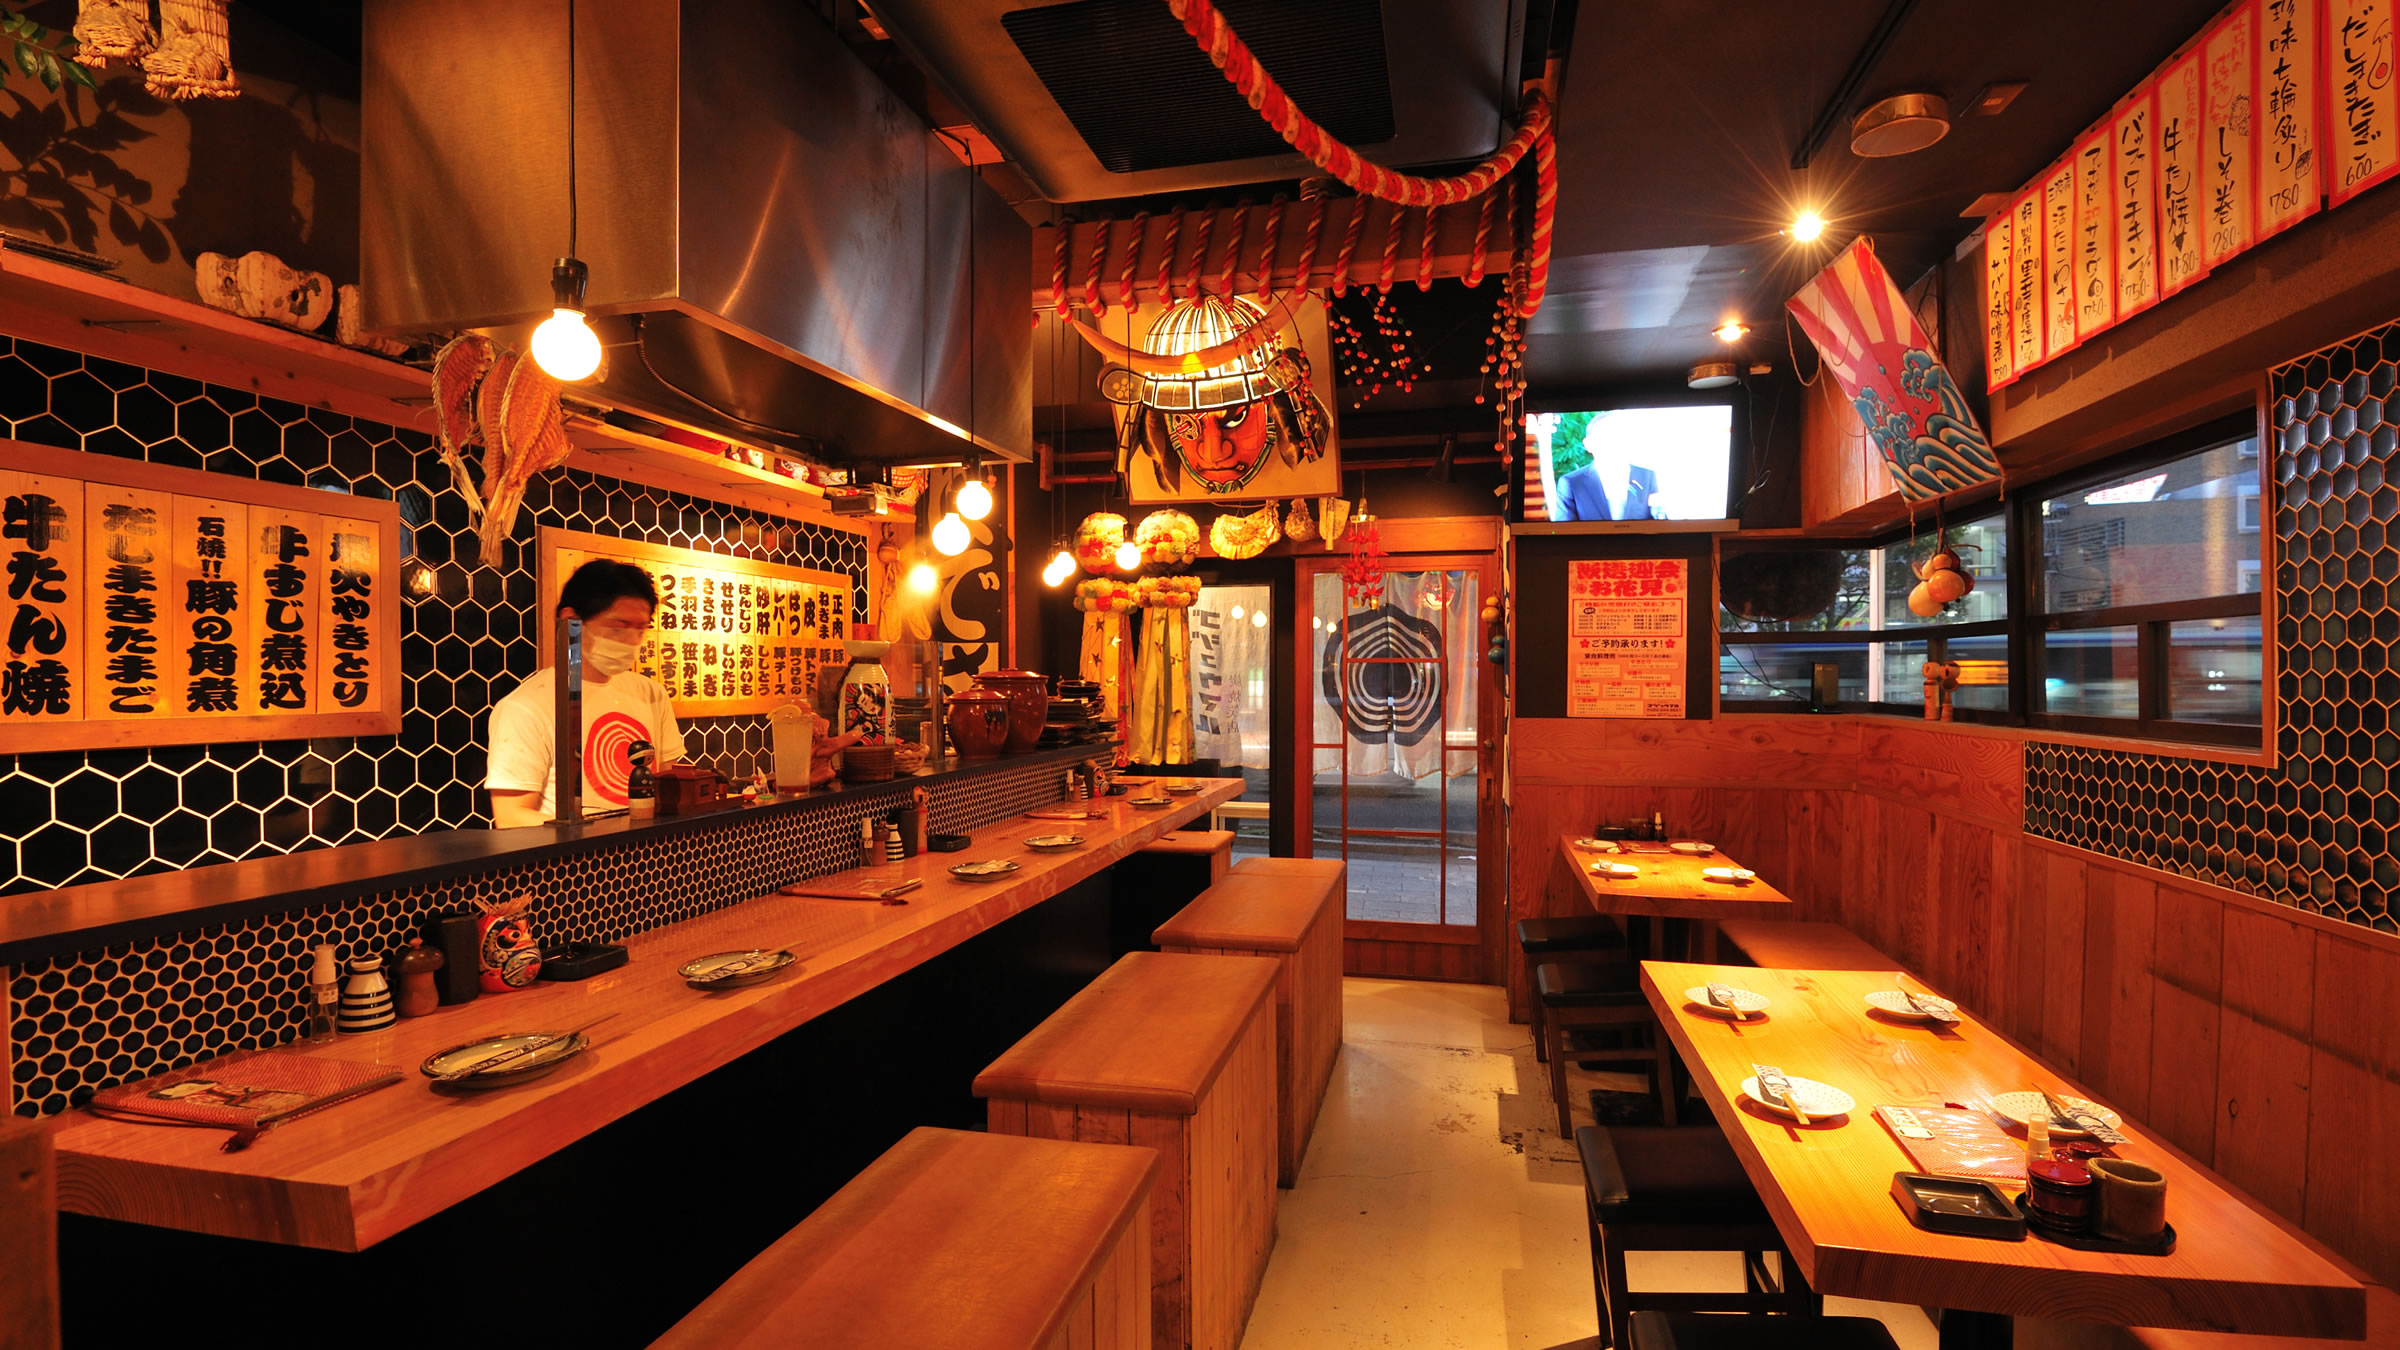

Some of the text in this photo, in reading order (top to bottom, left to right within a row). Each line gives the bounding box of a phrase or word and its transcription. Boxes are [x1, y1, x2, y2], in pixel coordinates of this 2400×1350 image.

[2, 494, 71, 716] 牛たん焼
[103, 503, 158, 713] だしまきたまご
[660, 574, 678, 630] つくね
[680, 576, 698, 631] 手羽先
[702, 577, 716, 632] ささみ
[720, 581, 735, 633] せせり
[773, 588, 785, 637] レバー
[804, 597, 816, 628] 皮
[819, 590, 830, 640] ねぎま
[1589, 580, 1664, 597] お花見
[832, 594, 844, 640] 正肉
[703, 643, 718, 697] ねぎ
[722, 643, 736, 697] しいたけ
[740, 644, 754, 697] ながいも
[758, 645, 770, 696] ししとう
